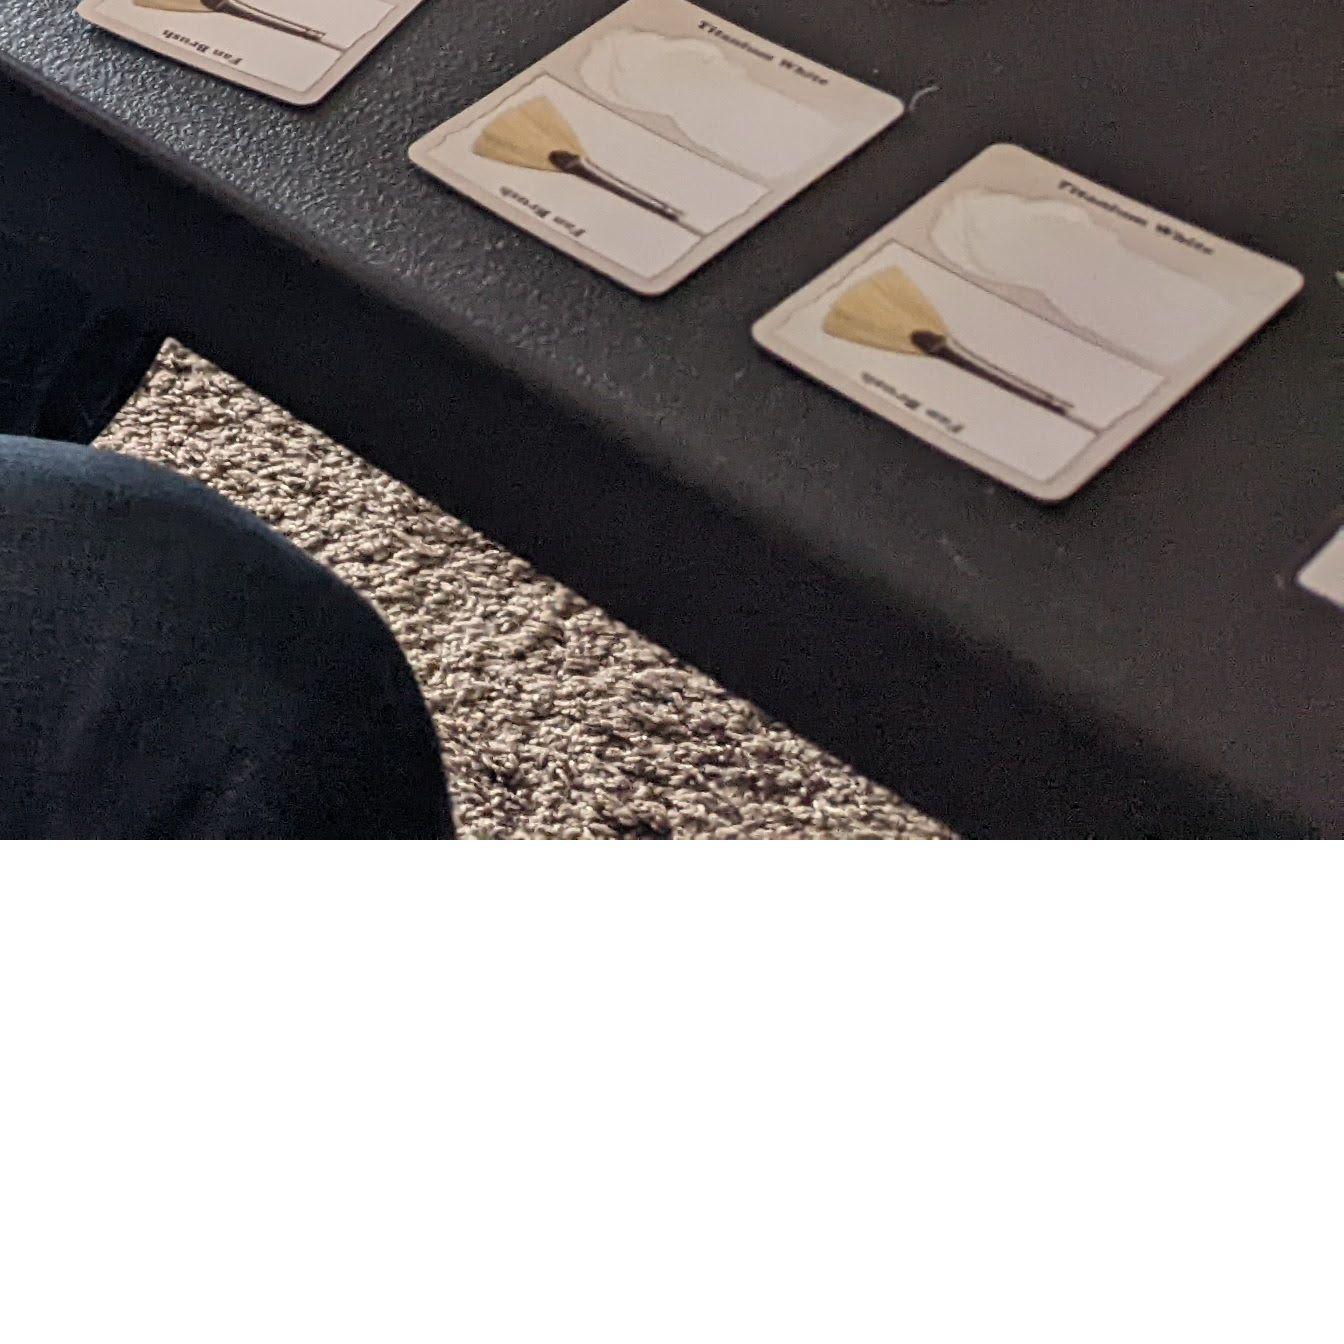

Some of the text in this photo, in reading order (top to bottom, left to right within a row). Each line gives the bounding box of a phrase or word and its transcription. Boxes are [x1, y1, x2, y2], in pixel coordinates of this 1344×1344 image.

[162, 29, 243, 65] Fan Brush
[698, 19, 829, 86] Titanium White
[499, 186, 586, 237] Fan Brush
[1155, 223, 1215, 255] White
[861, 372, 921, 410] Brush
